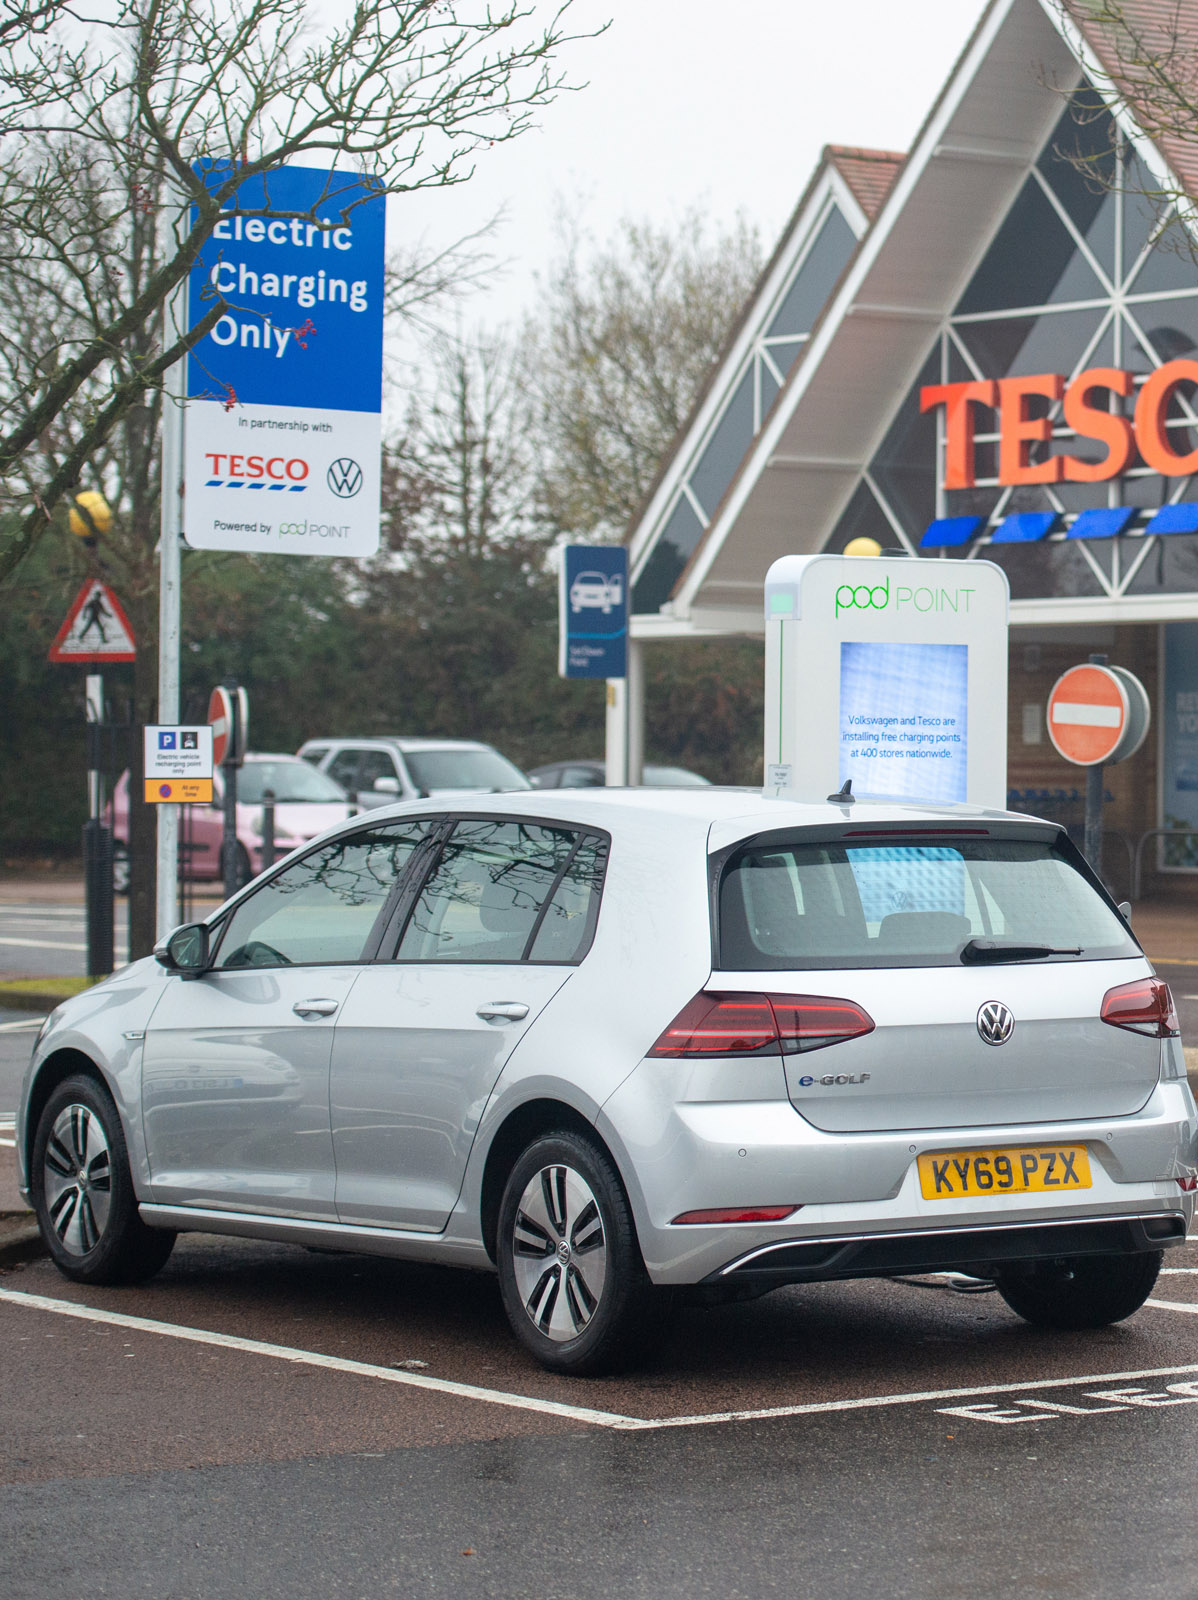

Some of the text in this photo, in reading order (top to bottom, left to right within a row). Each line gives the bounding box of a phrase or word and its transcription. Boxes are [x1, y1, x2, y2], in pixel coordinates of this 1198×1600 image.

[212, 209, 353, 251] Electric
[210, 261, 368, 313] Charging
[209, 314, 293, 358] Only
[238, 416, 333, 433] In partnership with
[205, 453, 310, 481] TESCO
[213, 519, 351, 539] Powered by pod POINT
[835, 575, 977, 619] pod POINT
[848, 715, 956, 728] Volkswagen and Tesco are
[842, 732, 961, 744] installing free charging points
[850, 748, 953, 759] at 400 stores nationwide.
[799, 1072, 872, 1087] e-GOLF
[932, 1151, 1080, 1194] KY69 PZX
